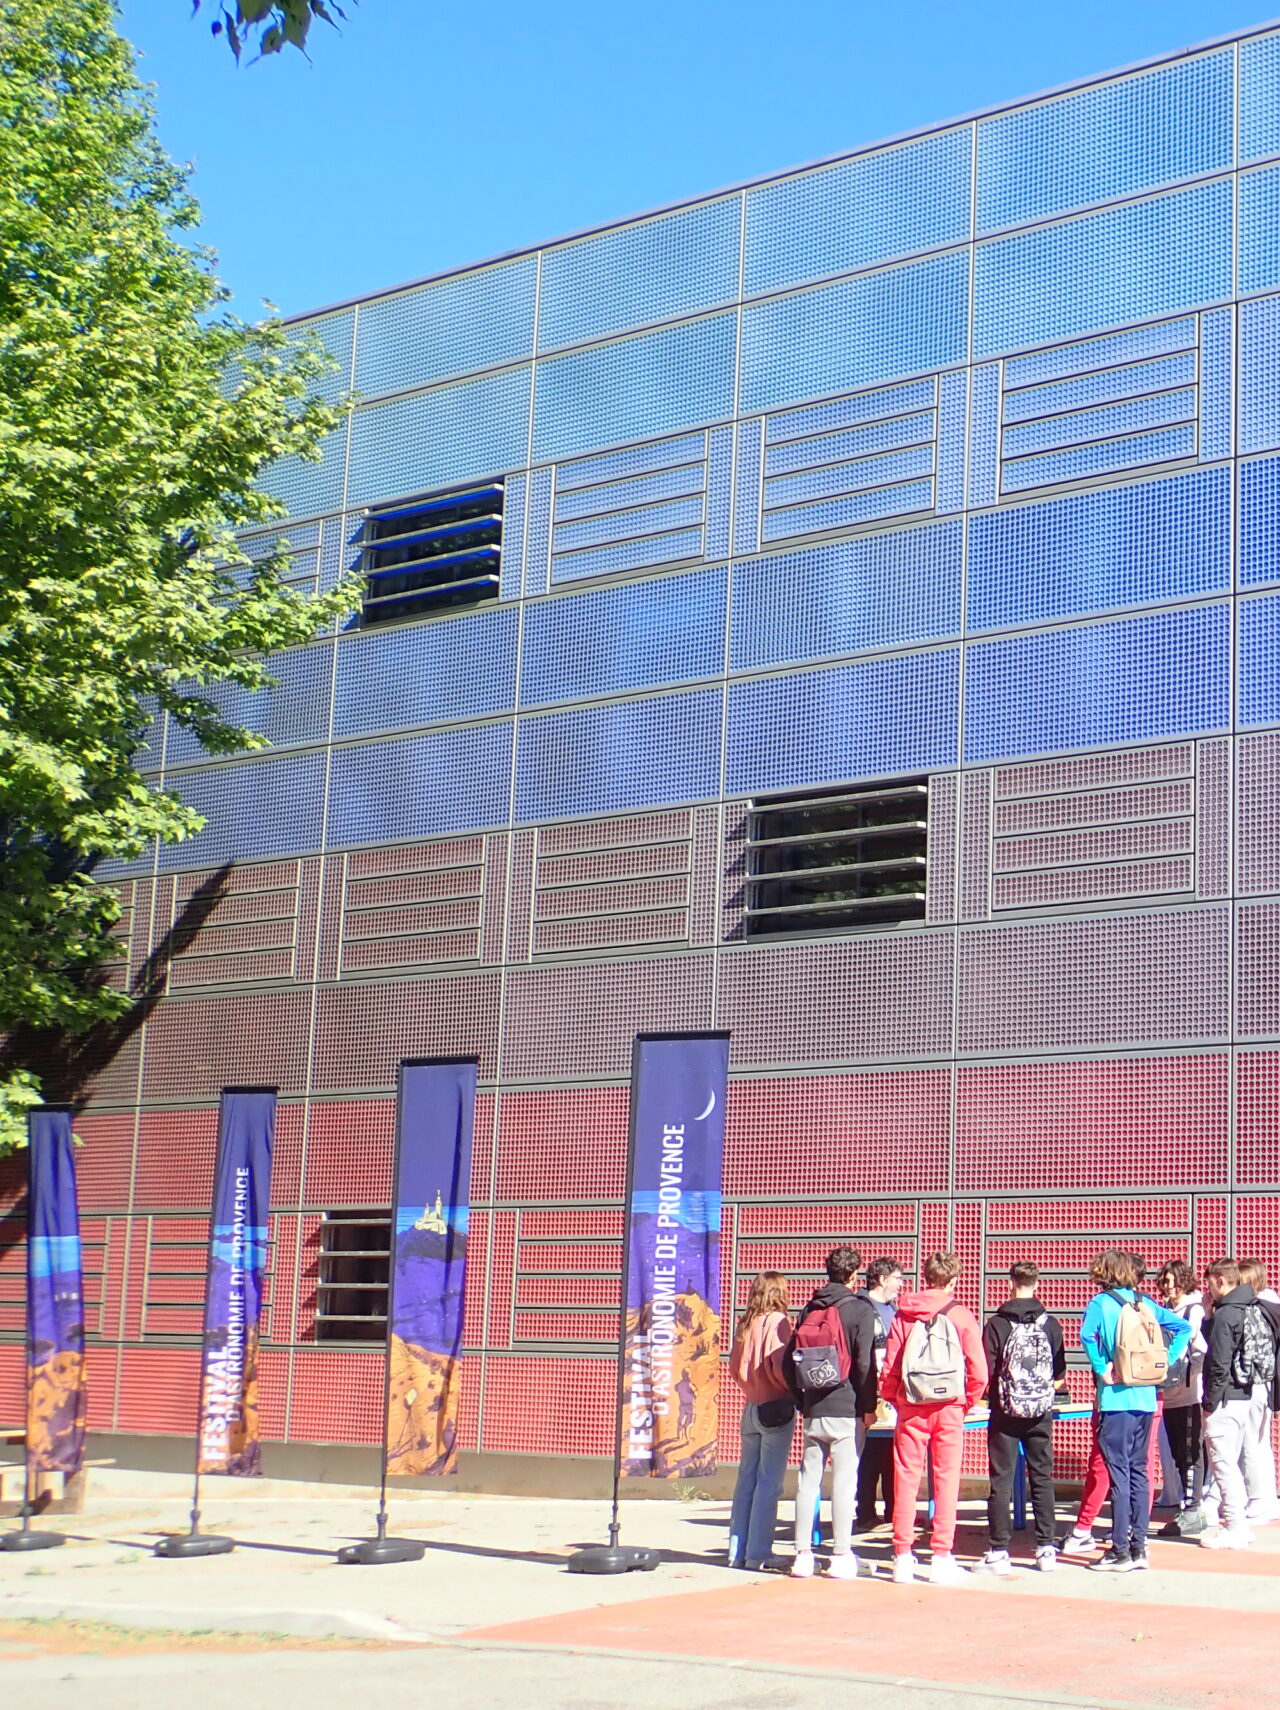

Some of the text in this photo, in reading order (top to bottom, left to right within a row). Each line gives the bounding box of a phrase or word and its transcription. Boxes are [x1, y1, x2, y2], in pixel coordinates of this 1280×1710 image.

[231, 1167, 249, 1258] PROVENCE
[652, 1124, 685, 1416] D'ASTRONOMIE DE PROVENCE
[202, 1346, 227, 1461] FESTIVAL
[628, 1329, 653, 1460] FESTIVAL
